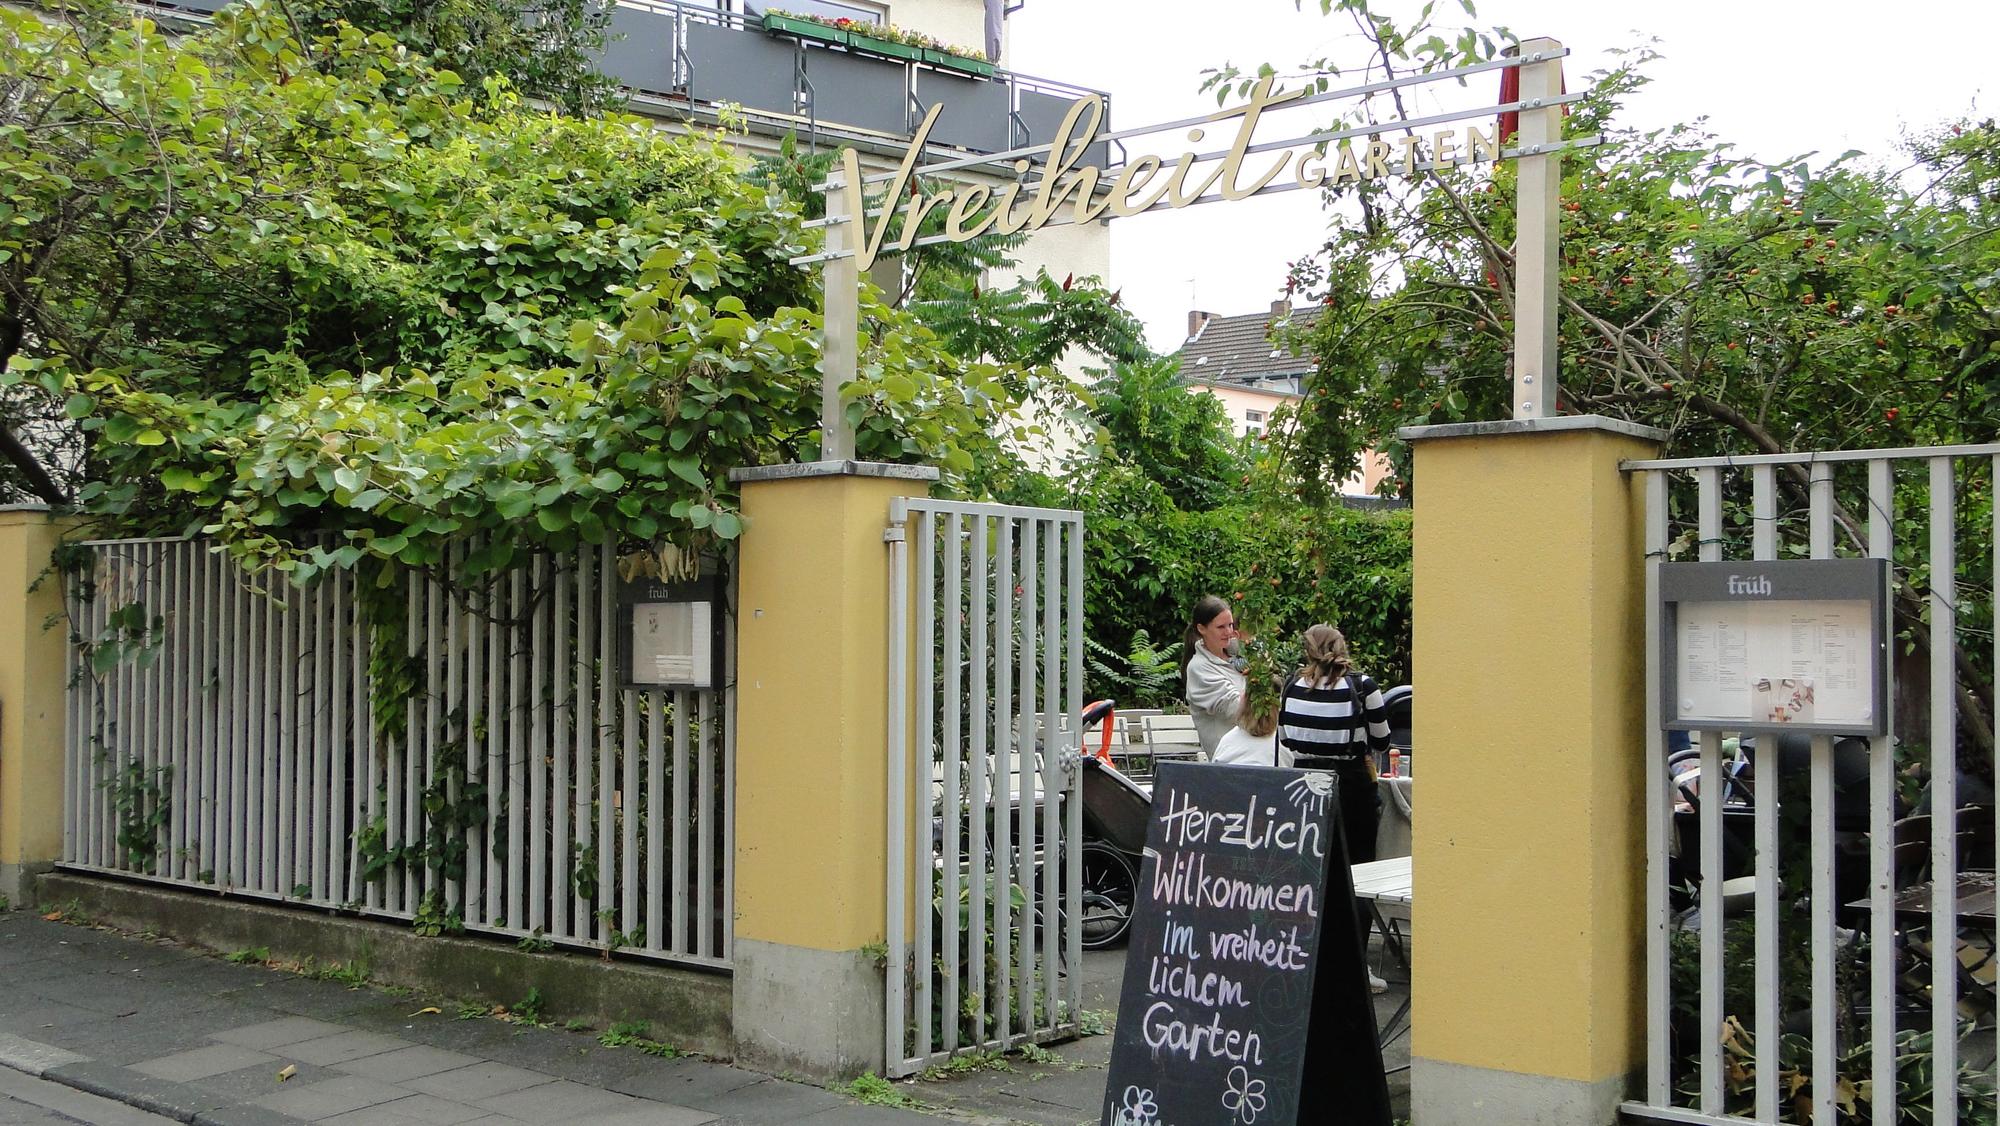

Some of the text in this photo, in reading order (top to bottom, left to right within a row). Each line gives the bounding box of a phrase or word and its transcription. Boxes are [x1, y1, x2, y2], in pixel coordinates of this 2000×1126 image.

[842, 75, 1501, 271] Vreiheit GARTEN
[1727, 574, 1772, 596] früh
[1160, 788, 1325, 857] Herzlich
[1143, 846, 1318, 917] Wilkommen
[1162, 910, 1200, 960] im
[1148, 956, 1250, 1007] lichem
[1142, 1001, 1263, 1066] Garten
